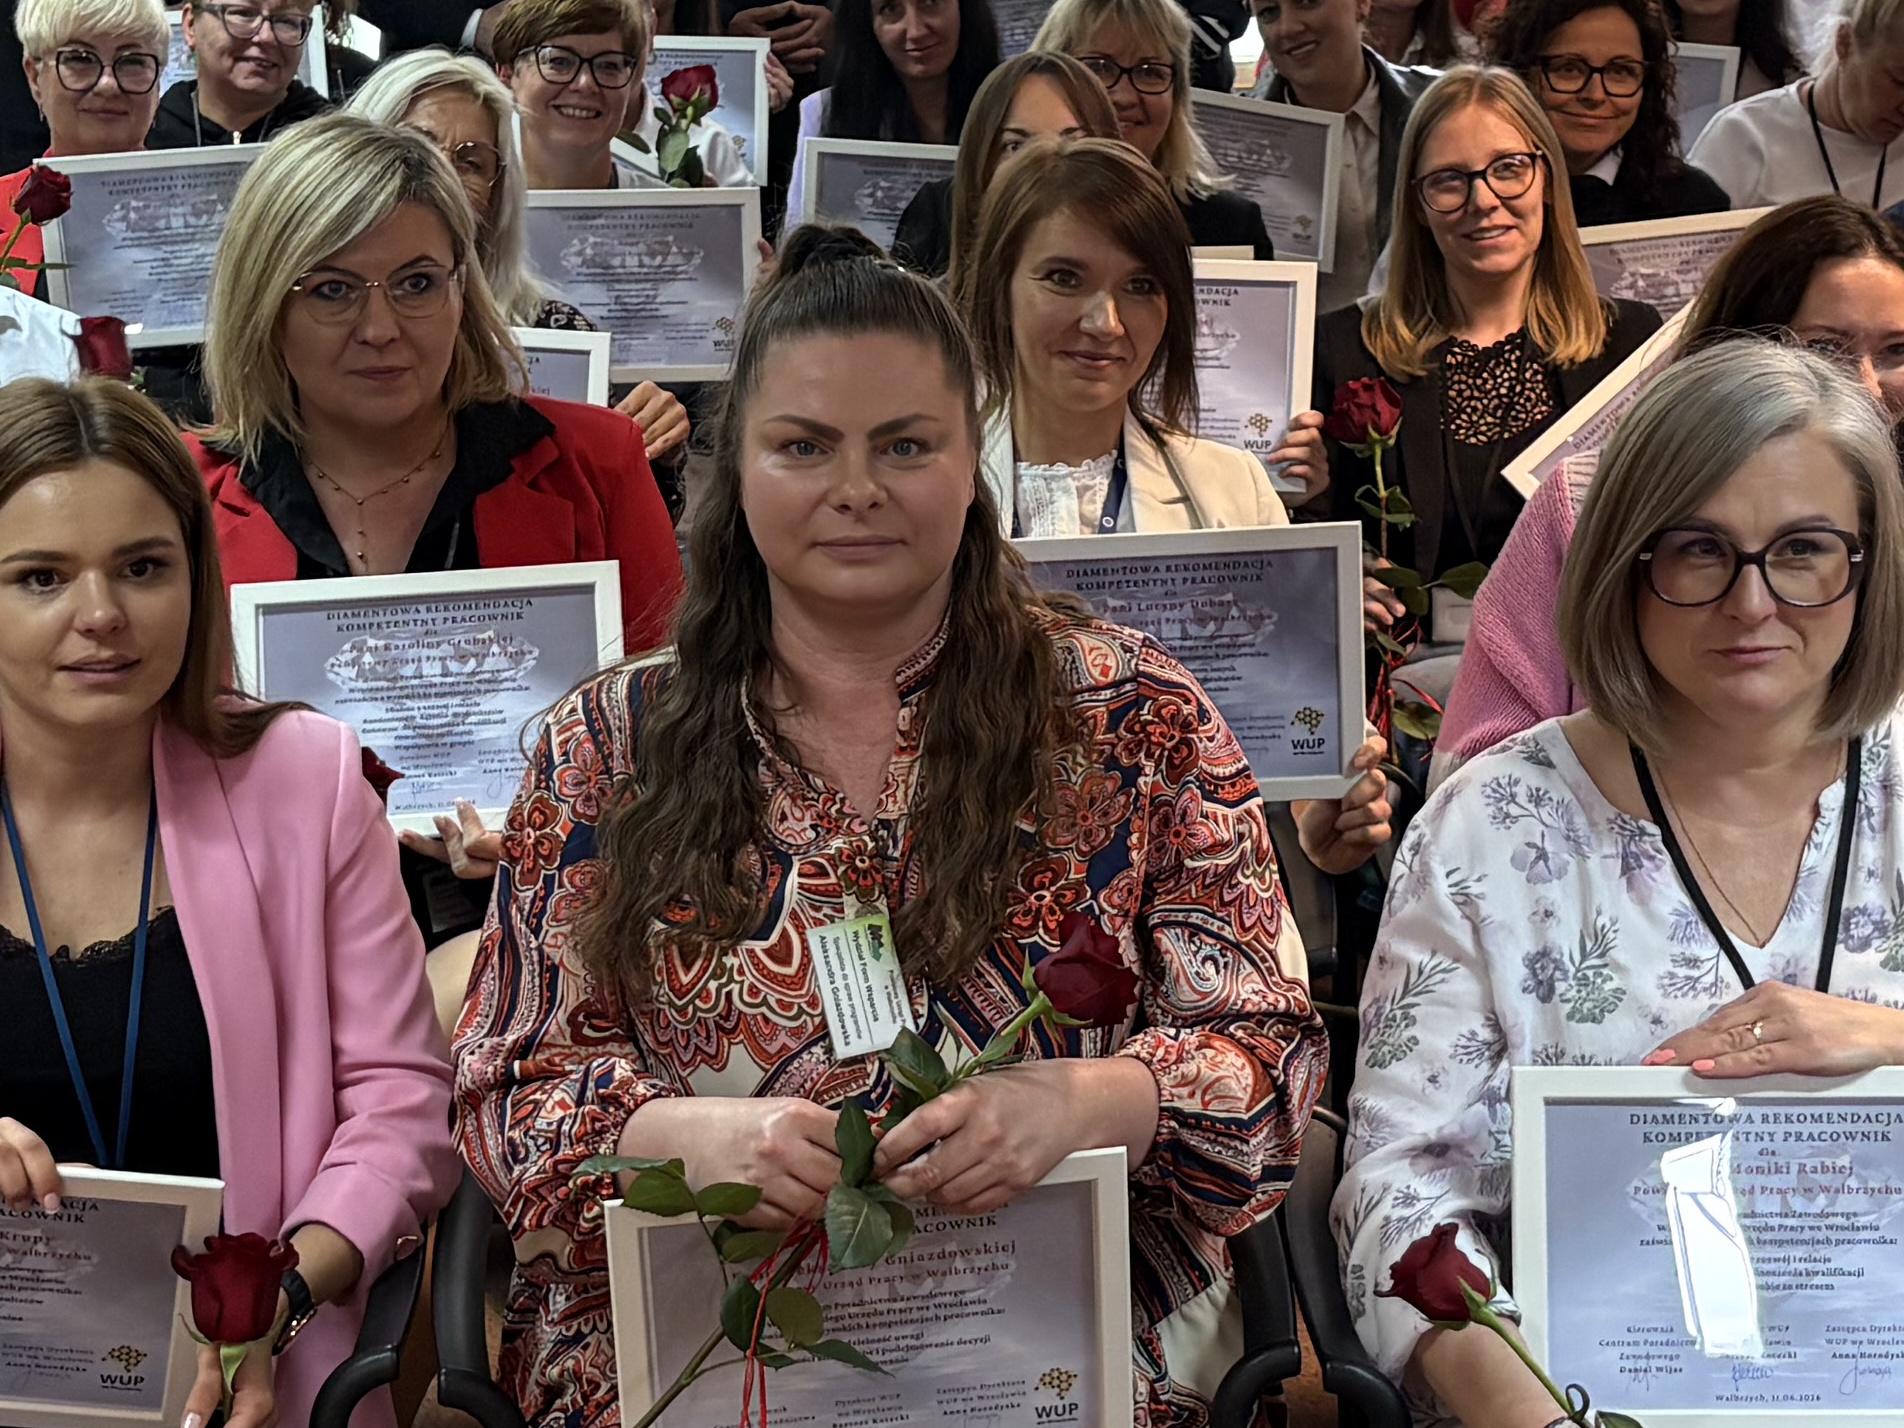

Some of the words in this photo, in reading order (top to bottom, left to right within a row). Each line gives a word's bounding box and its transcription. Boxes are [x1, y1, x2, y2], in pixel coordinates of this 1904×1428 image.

[1244, 440, 1272, 450] WUP
[1066, 564, 1161, 578] DIAMENTOWA
[1165, 559, 1273, 574] REKOMENDACJA
[1076, 577, 1177, 591] KOMPETENTNY
[1182, 573, 1264, 586] PRACOWNIK
[326, 605, 421, 621] DIAMENTOWA
[425, 598, 533, 614] REKOMENDACJA
[336, 617, 437, 633] KOMPETENTNY
[441, 610, 525, 625] PRACOWNIK
[1291, 737, 1325, 750] WUP
[1628, 1112, 1755, 1125] DIAMENTOWA
[1760, 1112, 1904, 1127] REKOMENDACJA
[1782, 1130, 1891, 1143] PRACOWNIK
[1760, 1184, 1797, 1197] Pracy
[1803, 1186, 1813, 1195] w
[912, 1214, 997, 1235] ACOWNIK
[885, 1239, 1016, 1268] Gniazdowskiej
[868, 1271, 905, 1286] Pracy
[98, 1372, 144, 1387] WUP
[1035, 1401, 1078, 1419] WUP
